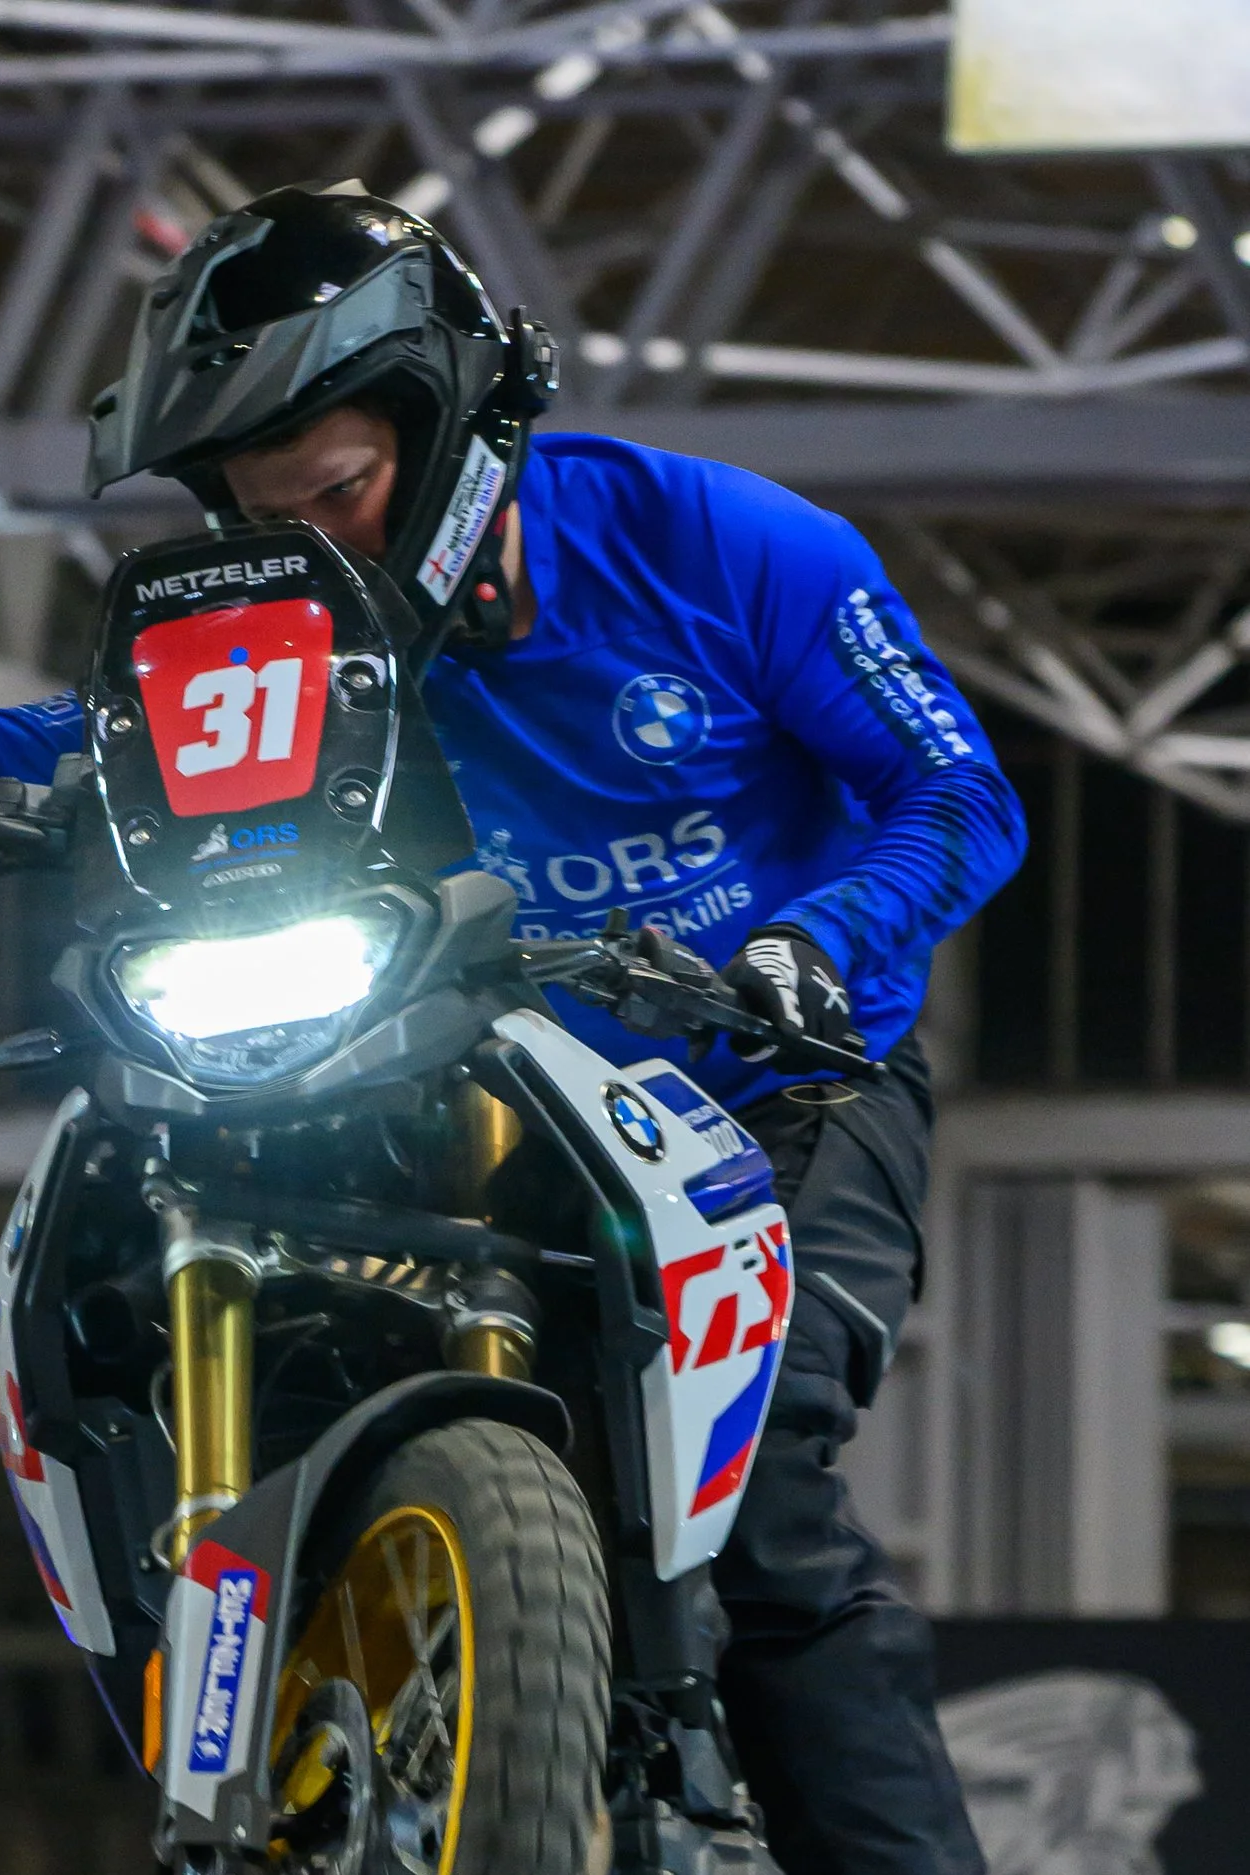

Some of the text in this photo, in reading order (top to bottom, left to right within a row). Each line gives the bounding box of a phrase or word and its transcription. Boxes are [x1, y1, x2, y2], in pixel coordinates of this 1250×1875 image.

[135, 554, 309, 603] METZELER
[847, 587, 974, 756] METZELER
[175, 657, 304, 778] 31
[230, 821, 300, 850] ORS
[546, 810, 727, 902] ORS
[641, 882, 752, 940] Skills
